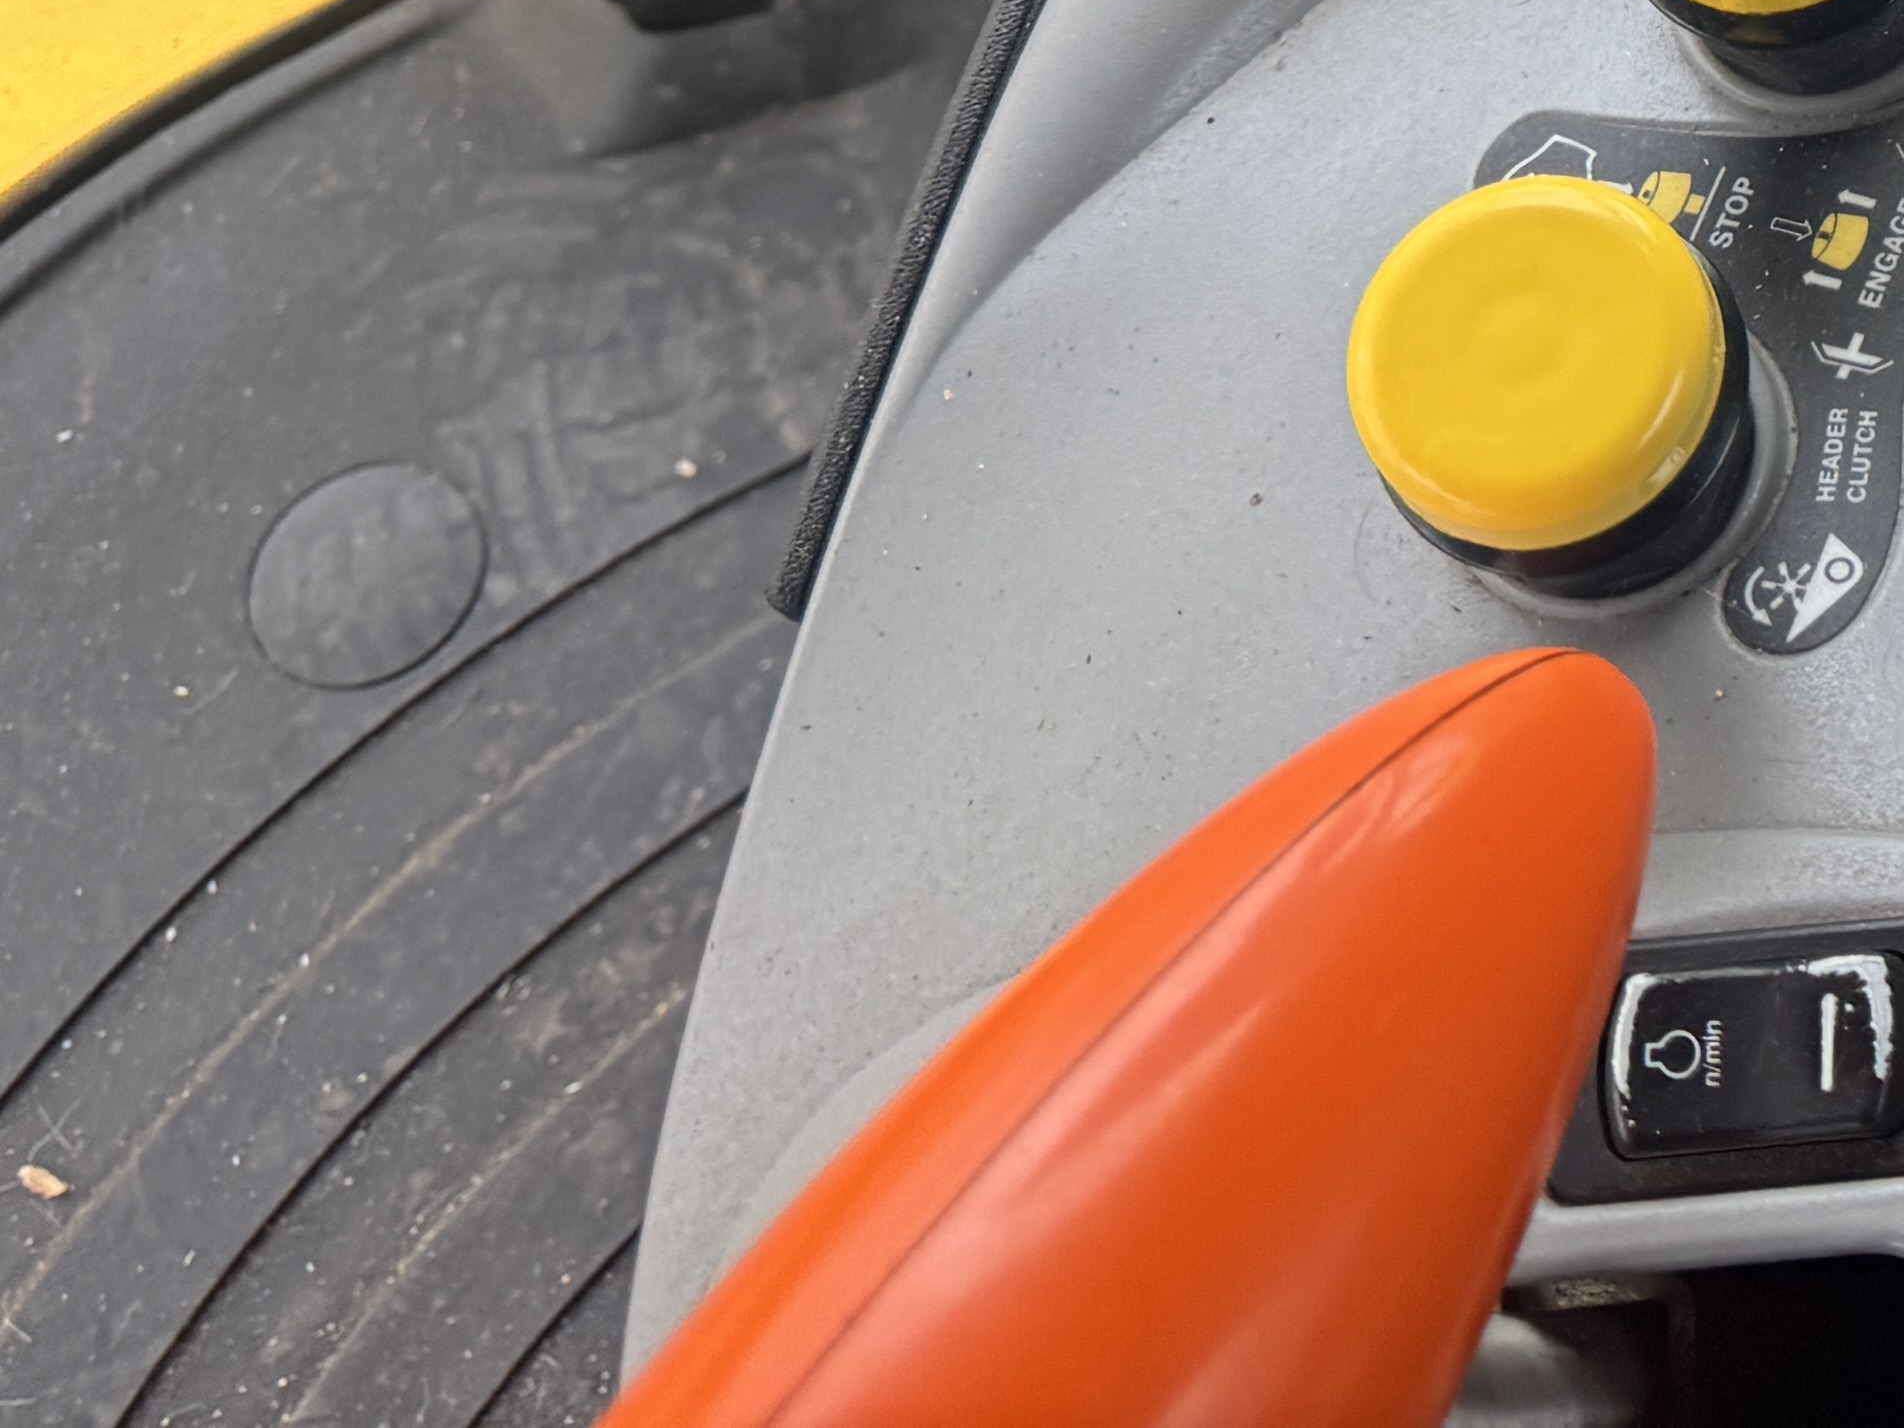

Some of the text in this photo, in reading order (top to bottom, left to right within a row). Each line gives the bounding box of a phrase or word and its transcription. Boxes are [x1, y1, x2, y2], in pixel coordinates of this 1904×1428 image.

[1709, 176, 1755, 250] STOP
[1816, 407, 1848, 503] HEADER
[1847, 410, 1878, 504] CLUTCH
[1702, 1019, 1723, 1088] n/min
